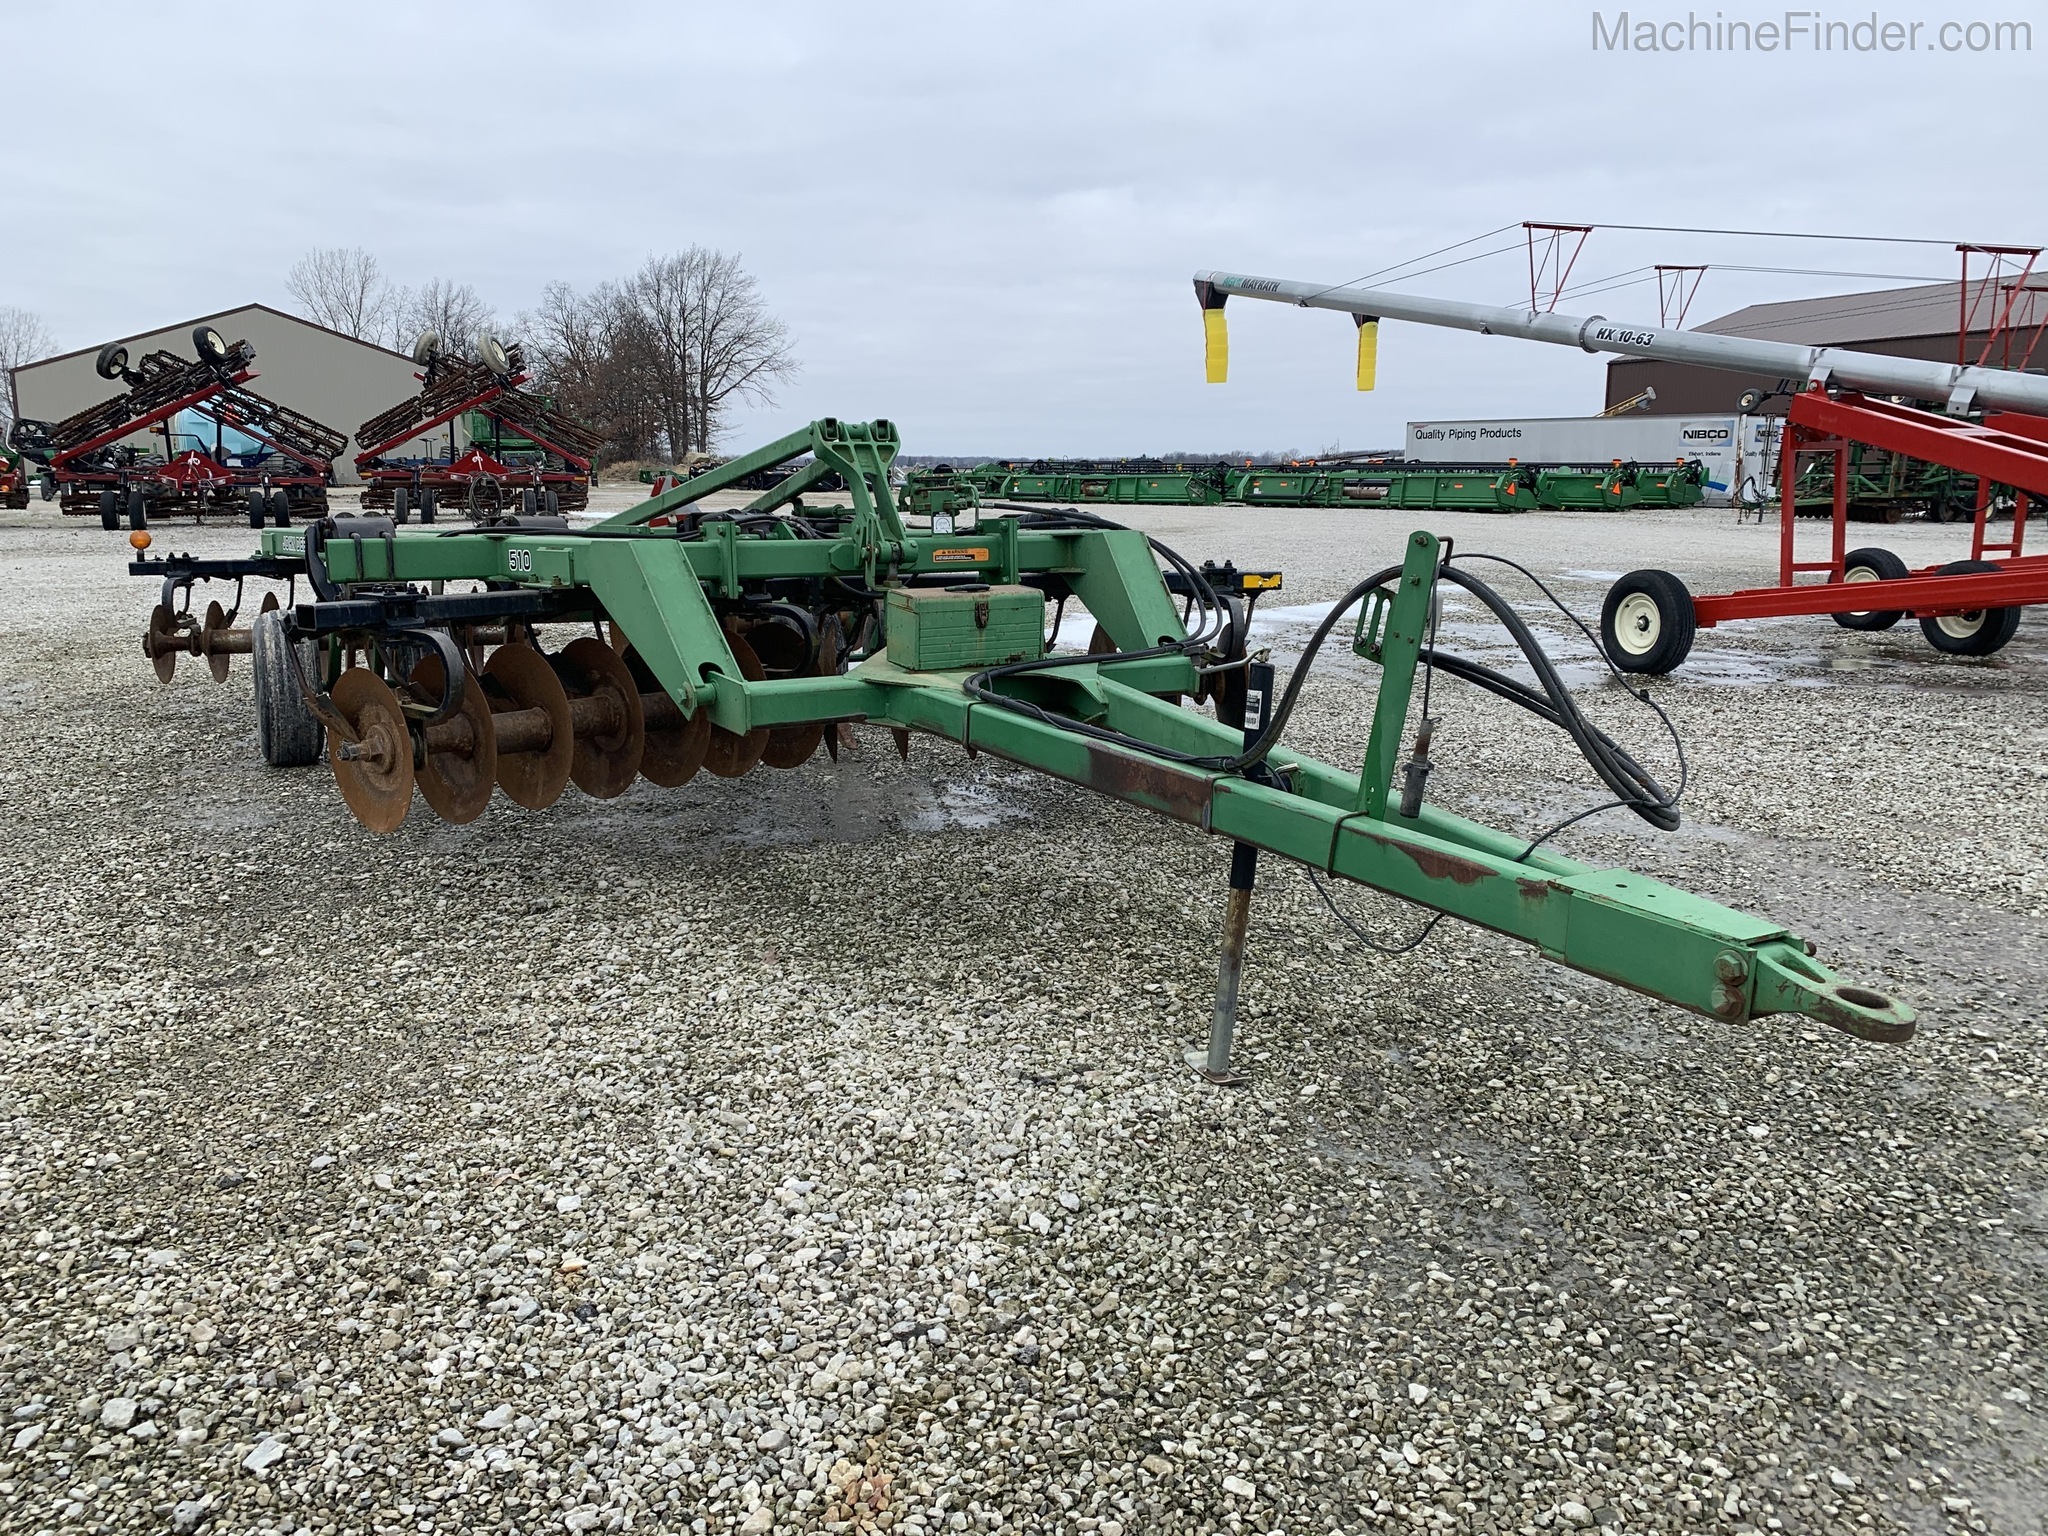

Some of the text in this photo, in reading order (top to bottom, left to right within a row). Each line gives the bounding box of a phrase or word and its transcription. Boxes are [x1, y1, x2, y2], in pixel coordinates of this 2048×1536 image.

[1241, 278, 1281, 292] MAYRATH
[1595, 327, 1655, 346] HX 10-63
[1415, 427, 1522, 441] Quality Piping Products
[1683, 429, 1729, 439] NIBCO
[508, 549, 532, 571] 510
